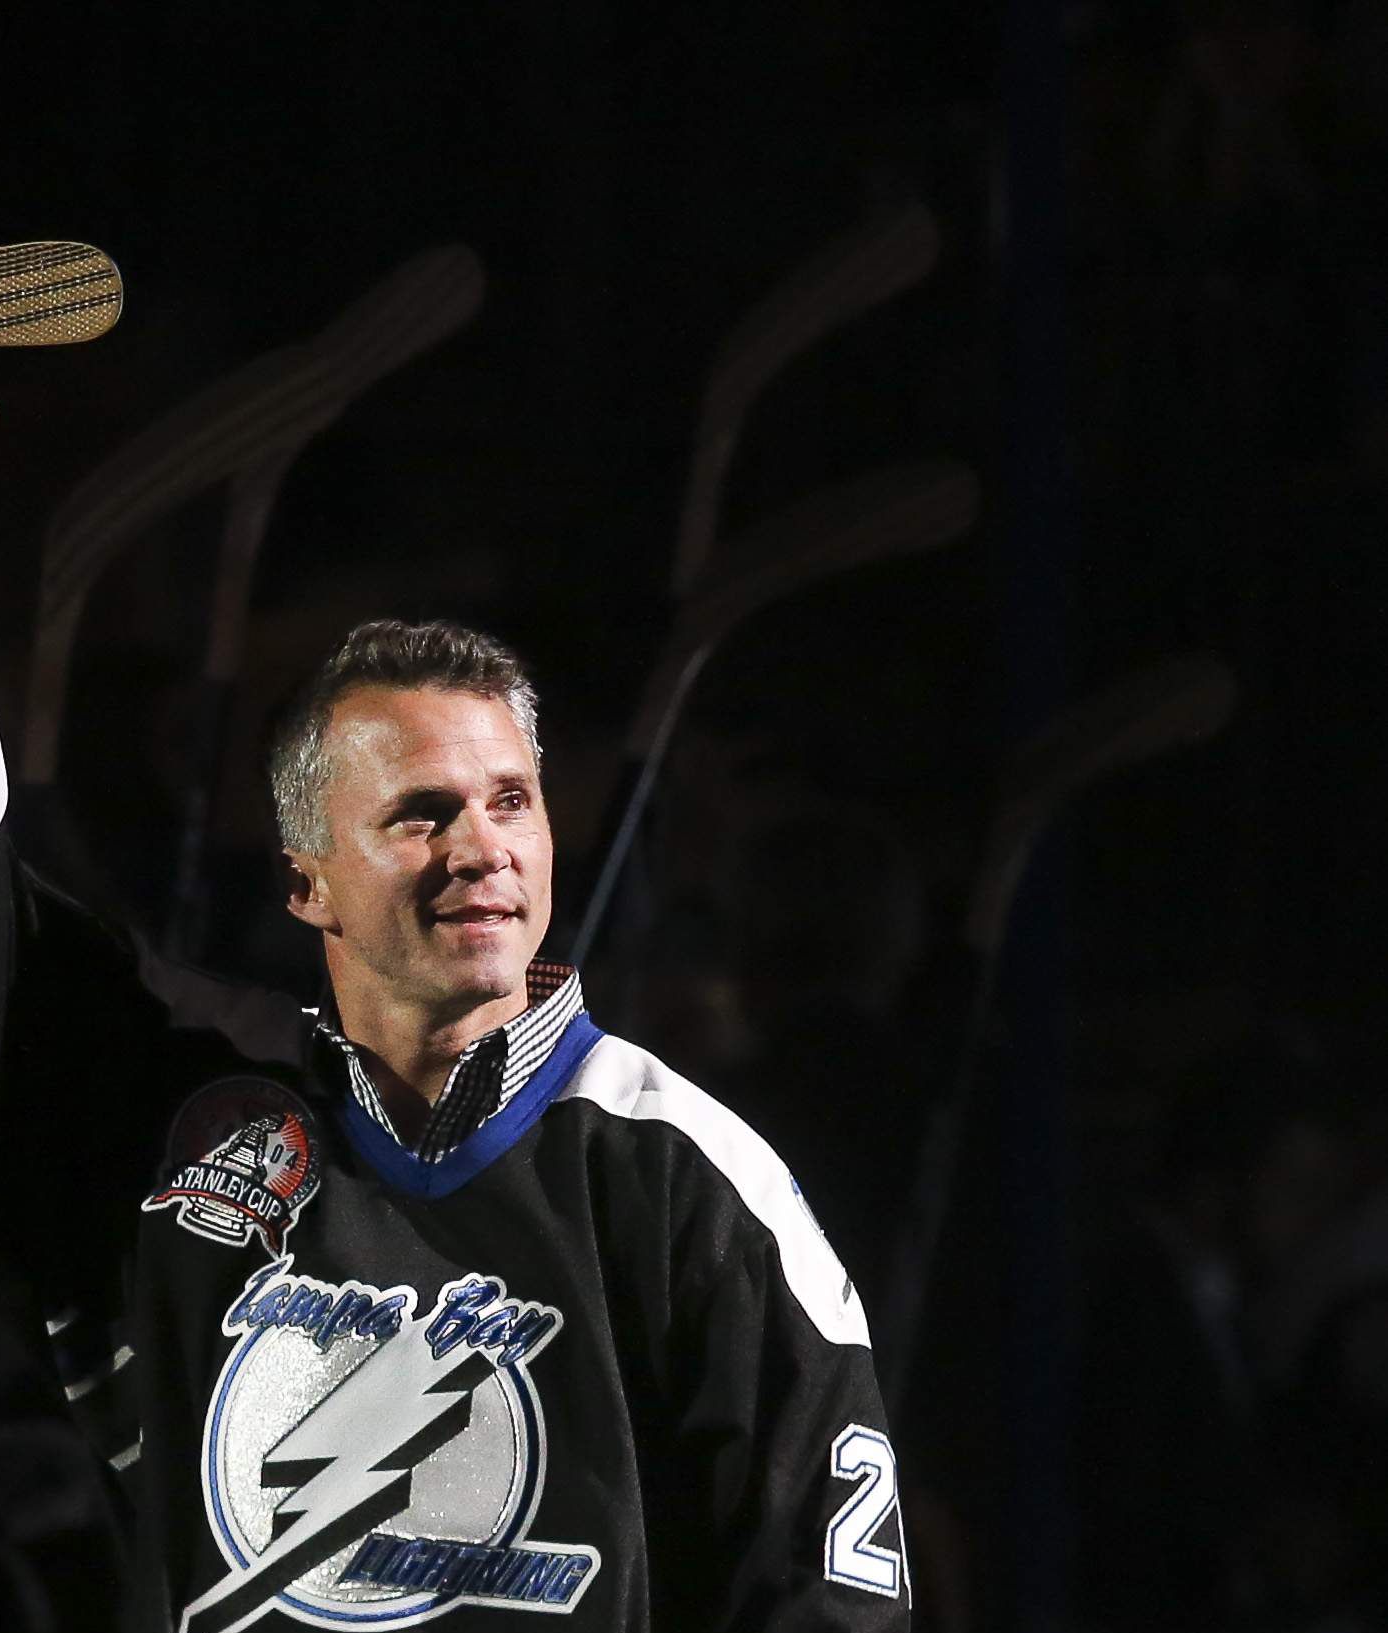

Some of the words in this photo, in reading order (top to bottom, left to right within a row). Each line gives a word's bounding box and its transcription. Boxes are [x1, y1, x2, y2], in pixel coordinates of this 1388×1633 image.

[171, 1165, 251, 1202] STANLEY
[246, 1186, 282, 1221] CUP
[227, 1258, 409, 1356] Tampa
[424, 1278, 557, 1368] Bay
[335, 1532, 593, 1604] LIGHTNING
